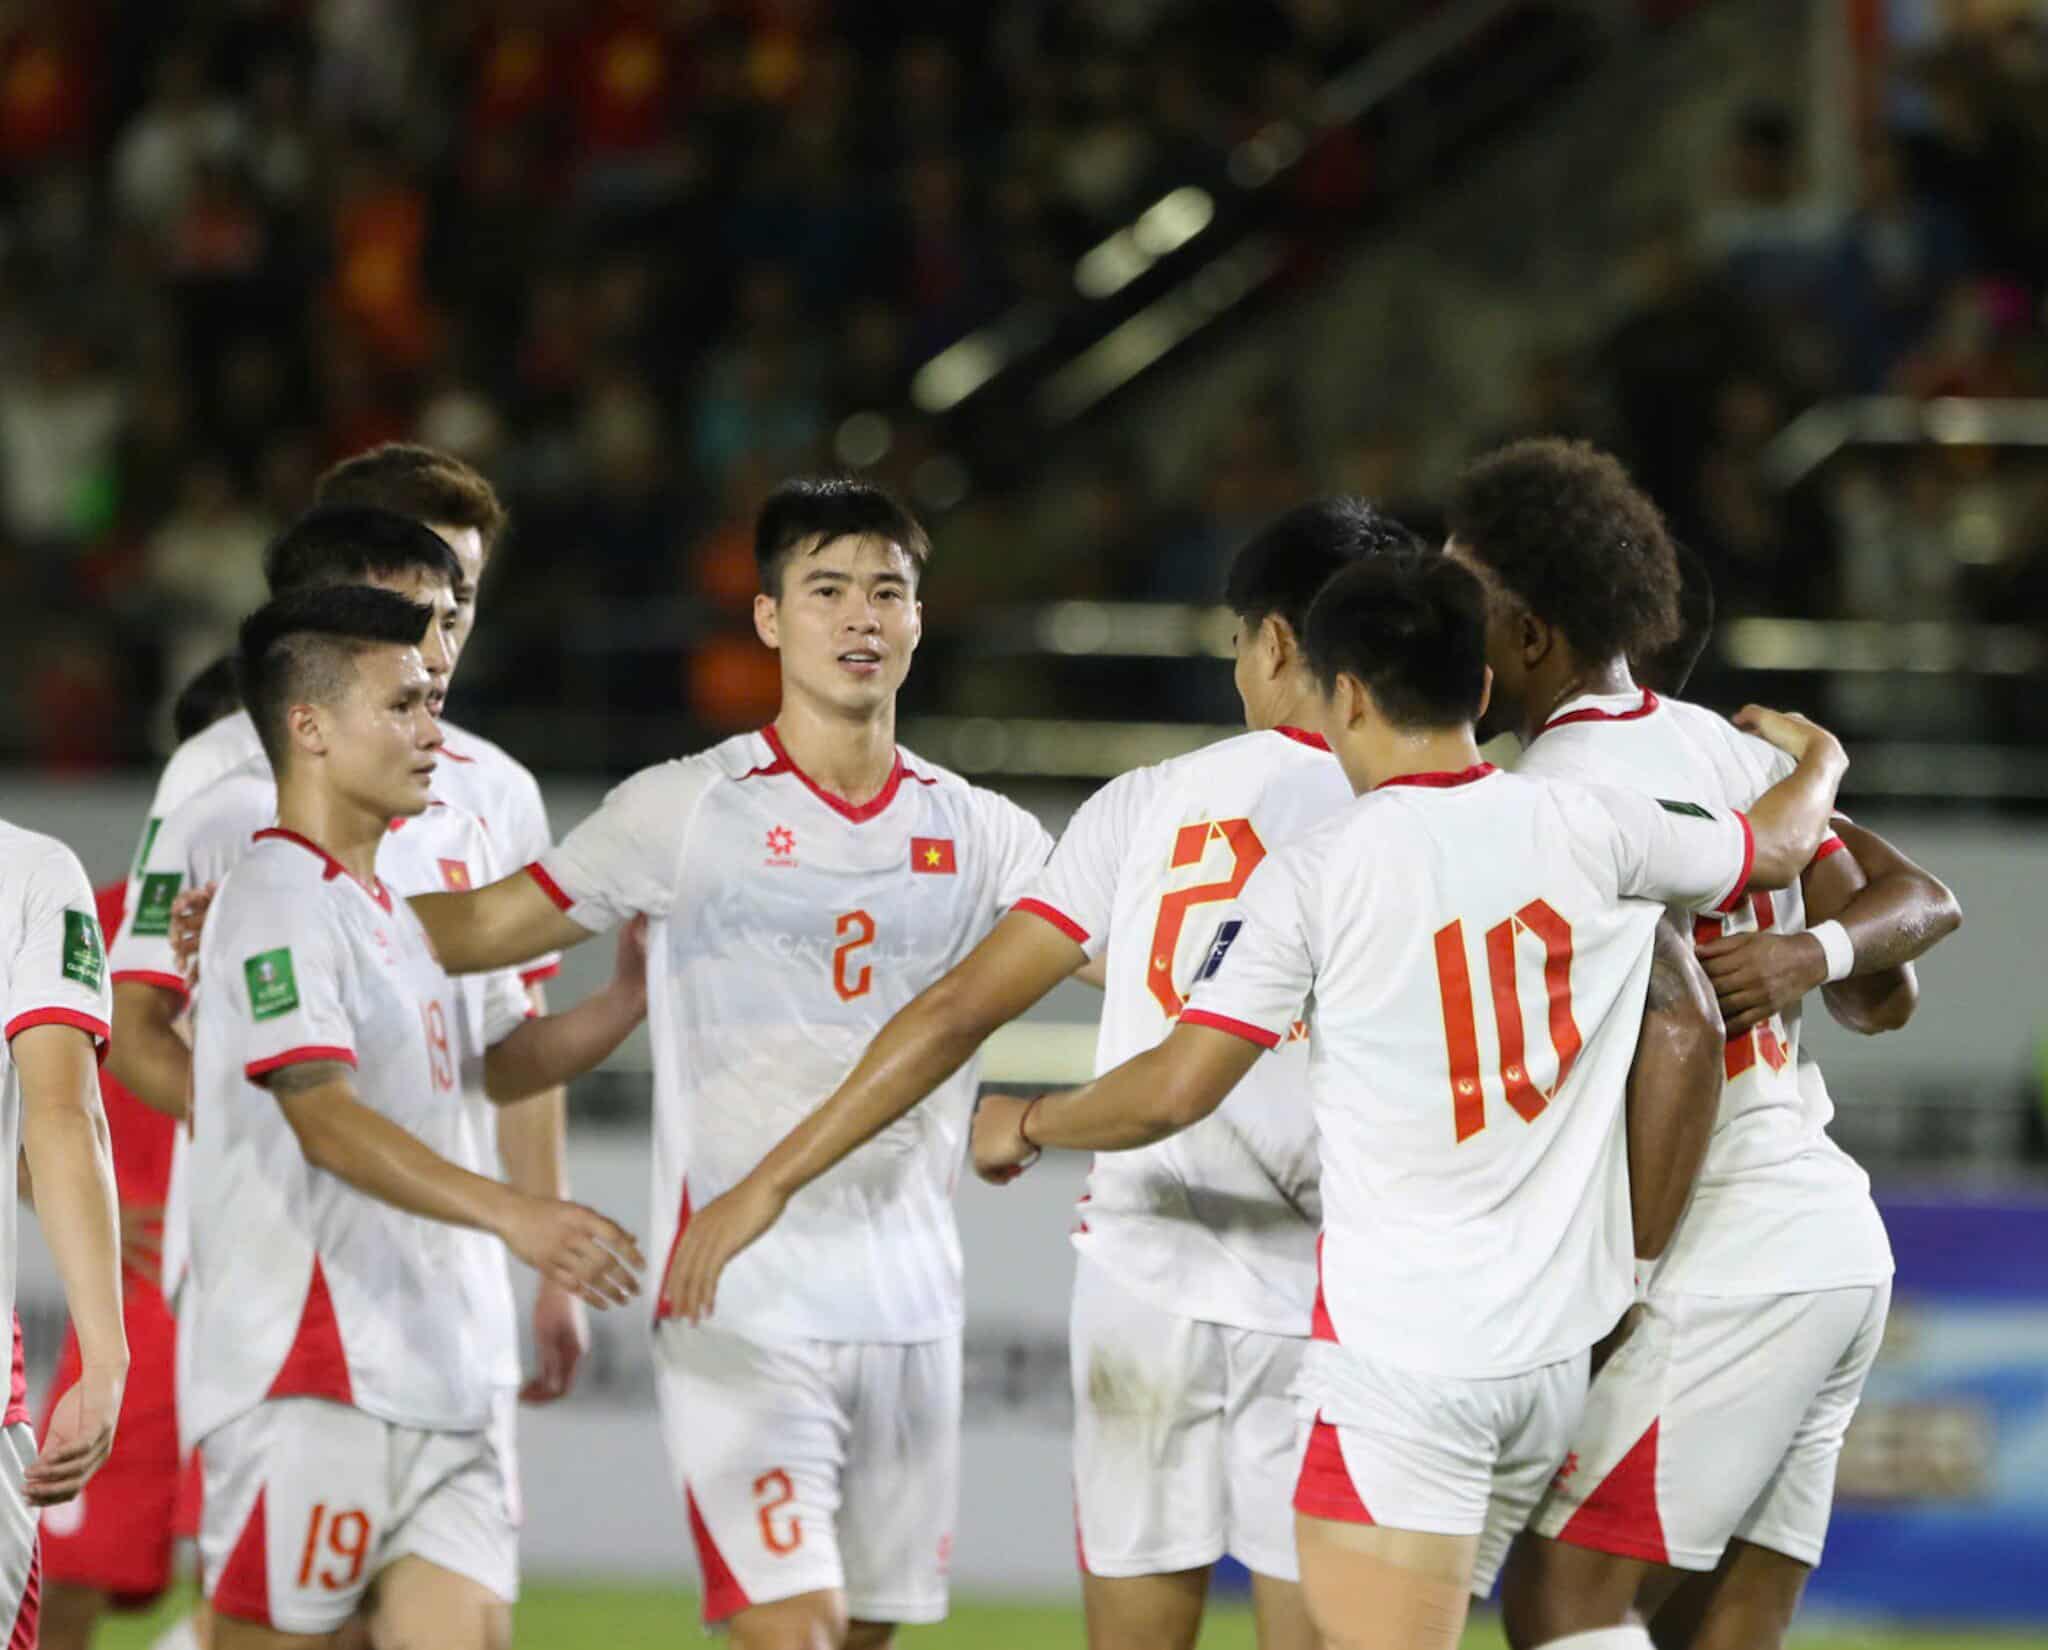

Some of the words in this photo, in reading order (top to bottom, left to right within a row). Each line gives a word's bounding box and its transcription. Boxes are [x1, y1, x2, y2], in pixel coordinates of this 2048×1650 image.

[832, 909, 875, 1000] 2
[1433, 898, 1583, 1144] 10
[297, 1504, 371, 1590] 19
[753, 1468, 802, 1557] 2
